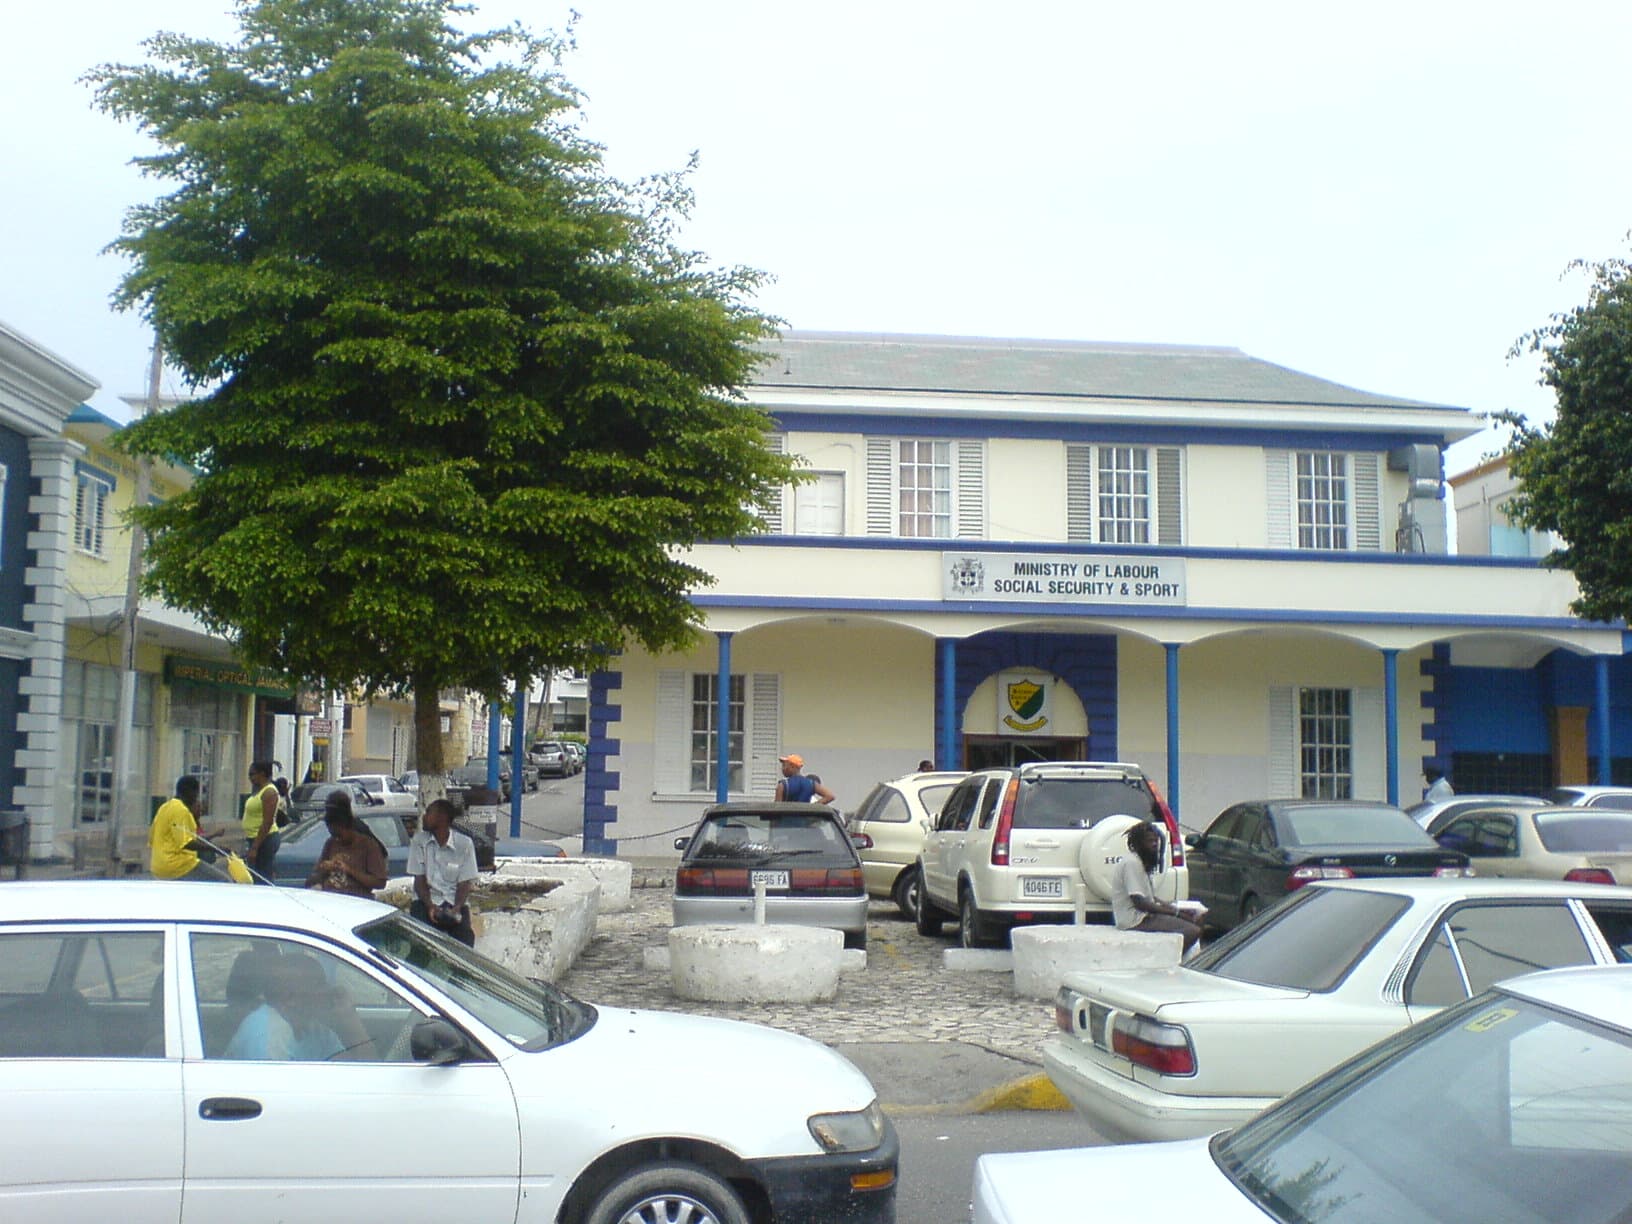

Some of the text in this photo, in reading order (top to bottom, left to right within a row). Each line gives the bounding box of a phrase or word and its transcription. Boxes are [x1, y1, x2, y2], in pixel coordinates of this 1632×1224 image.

[1014, 562, 1160, 579] MINISTRY OF LABOUR
[994, 579, 1180, 597] SOCIAL SECURITY & SPORT
[217, 670, 254, 686] OPTICAL
